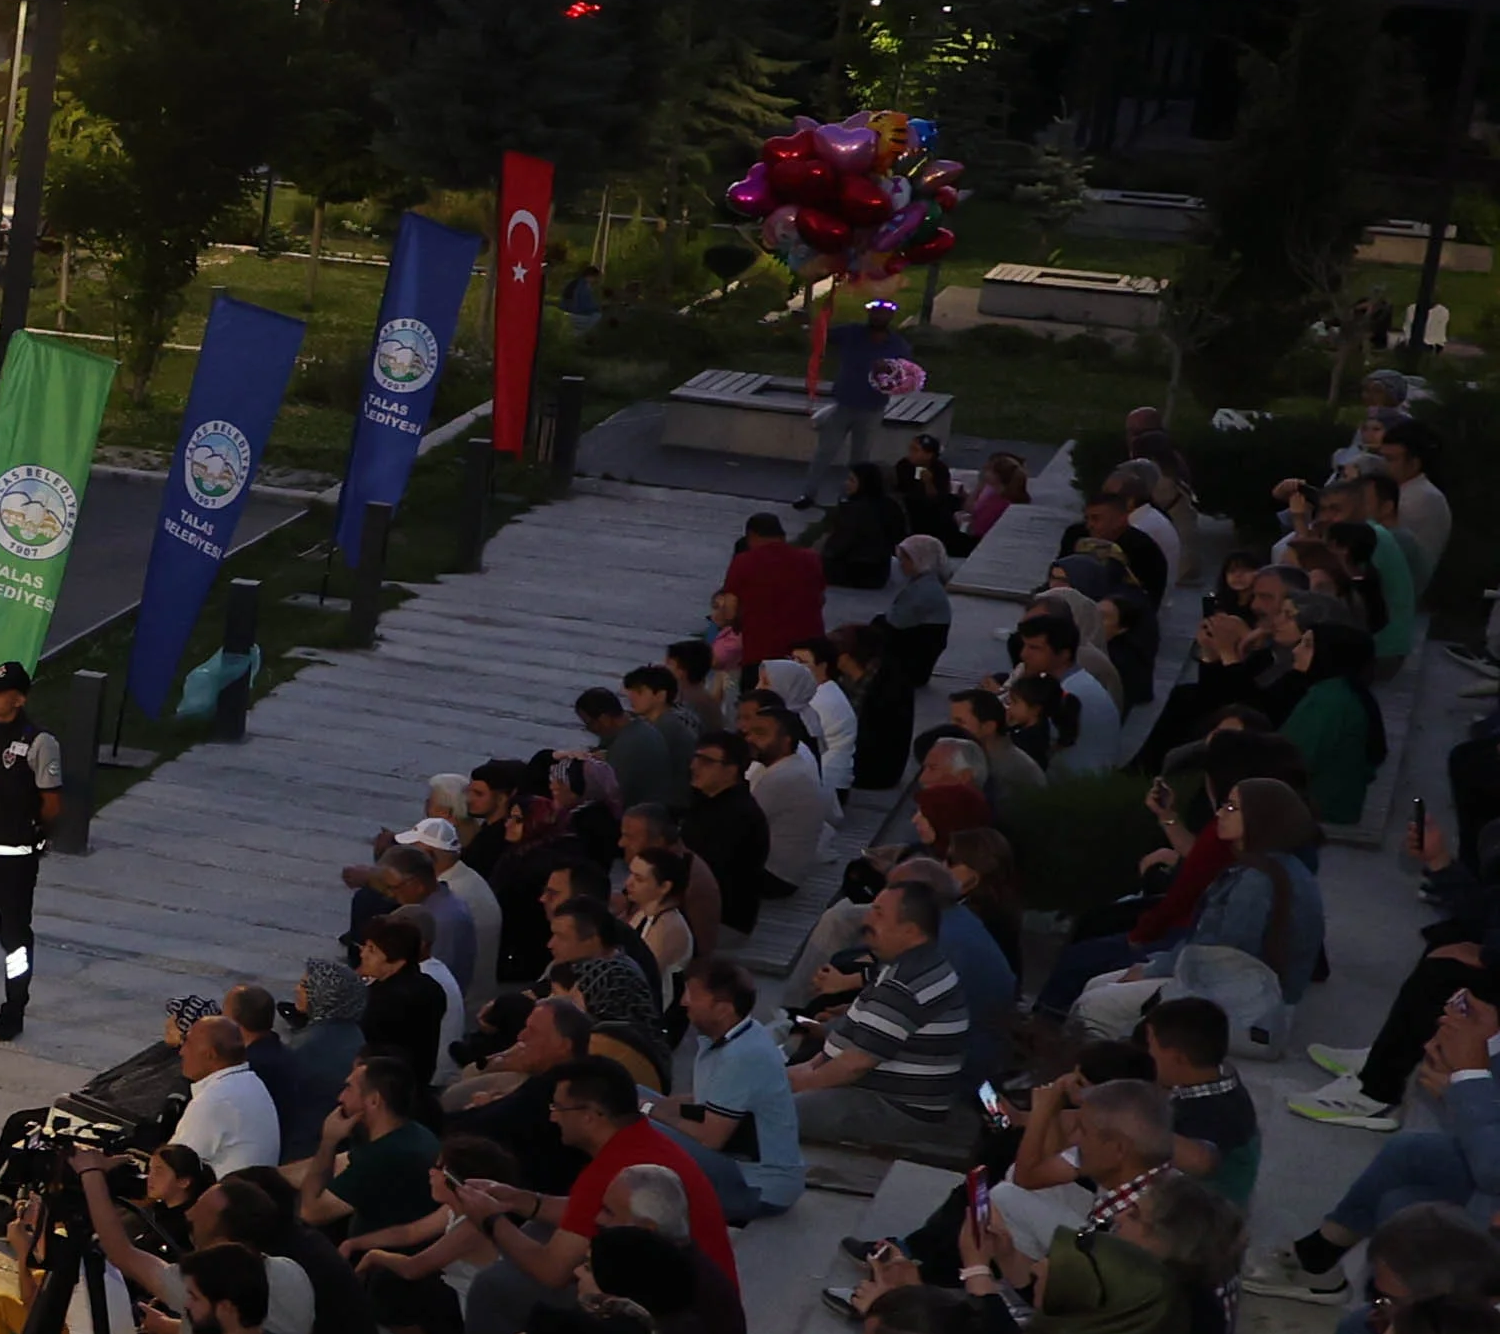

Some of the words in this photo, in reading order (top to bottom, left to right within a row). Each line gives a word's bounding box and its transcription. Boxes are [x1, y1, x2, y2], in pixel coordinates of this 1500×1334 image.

[368, 393, 409, 416] TALAS
[180, 509, 214, 536] TALAS
[9, 542, 40, 557] 1907
